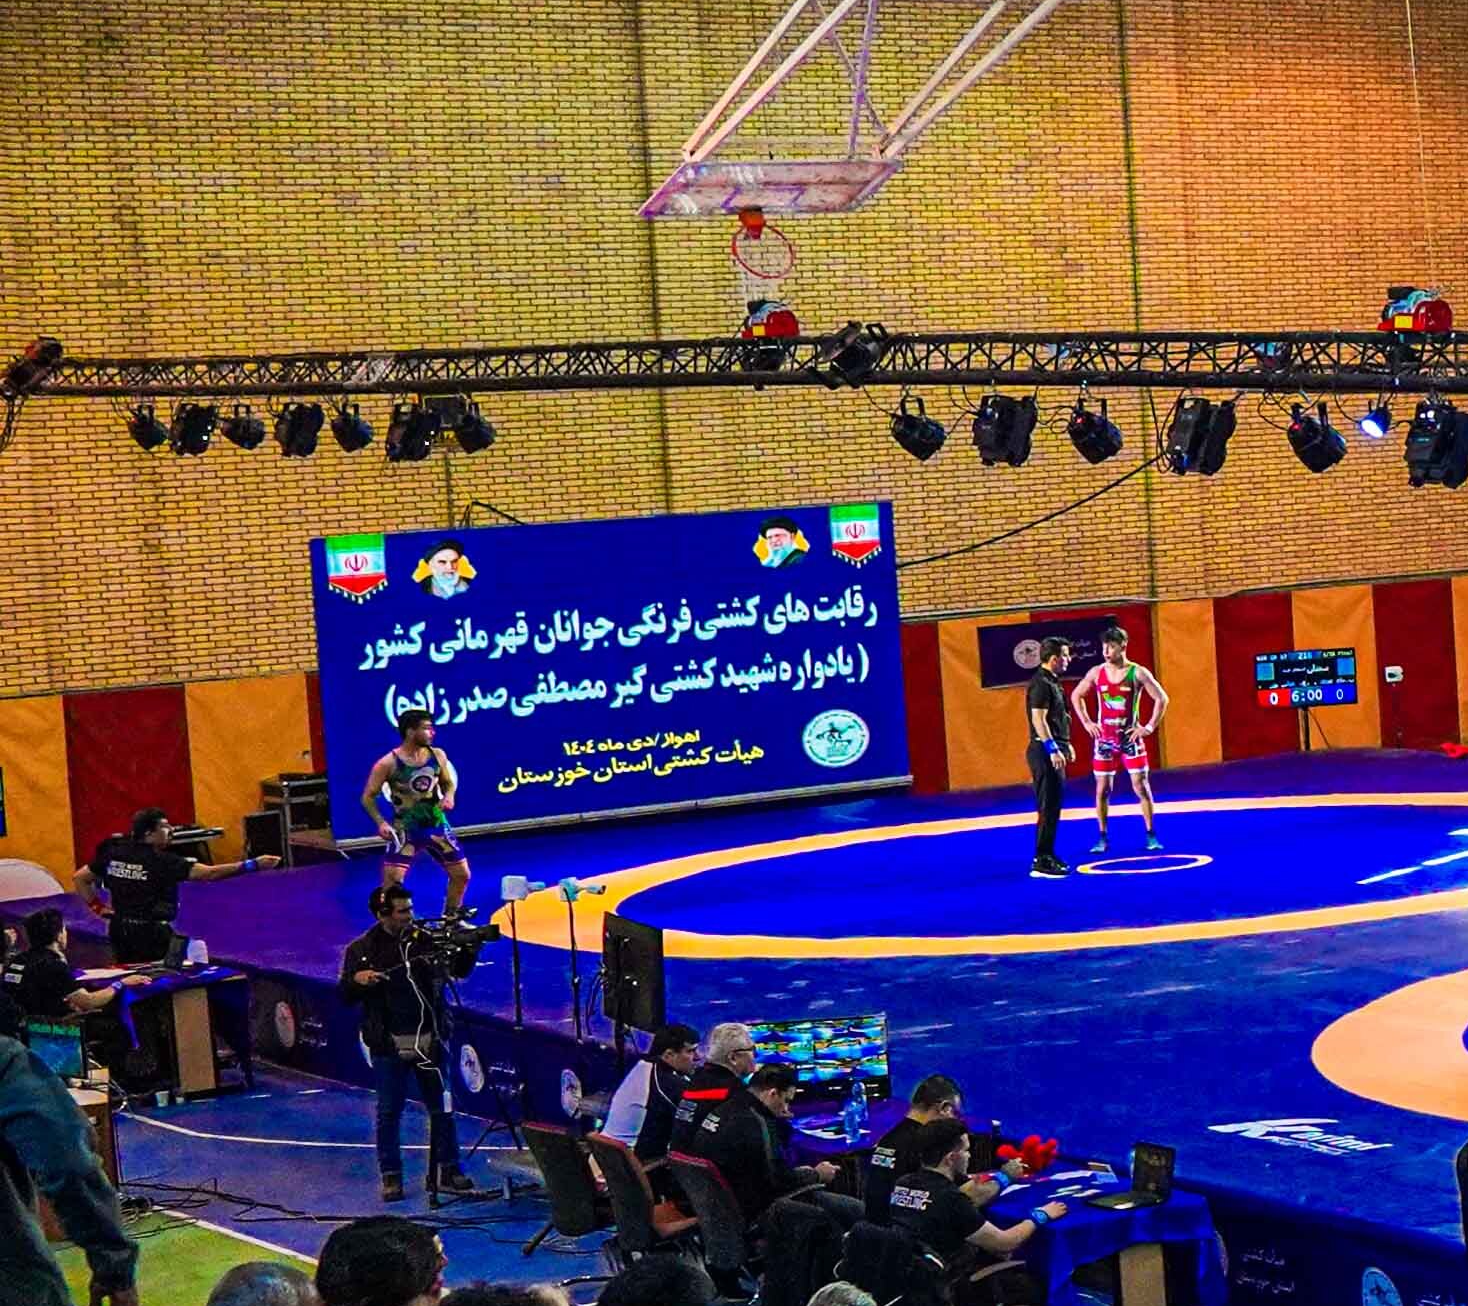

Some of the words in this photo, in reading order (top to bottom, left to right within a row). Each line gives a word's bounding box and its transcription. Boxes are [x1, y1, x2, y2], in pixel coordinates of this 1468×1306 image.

[617, 599, 692, 647] فرنگی
[694, 595, 760, 640] کشتی
[763, 592, 810, 634] های
[813, 585, 878, 627] رقابت
[358, 621, 426, 670] کشور
[429, 611, 529, 662] قهرمانی
[534, 609, 615, 654] جوانان
[510, 671, 607, 716] مصطفی
[609, 663, 648, 708] گیر
[650, 657, 717, 703] کشتی
[720, 652, 777, 693] شهید
[1269, 692, 1279, 705] 0
[1291, 689, 1322, 702] 6:00
[1336, 689, 1344, 700] 0
[598, 738, 624, 751] ماه
[653, 746, 713, 776] کشتی
[498, 762, 591, 793] خوزستان
[593, 754, 652, 782] استان
